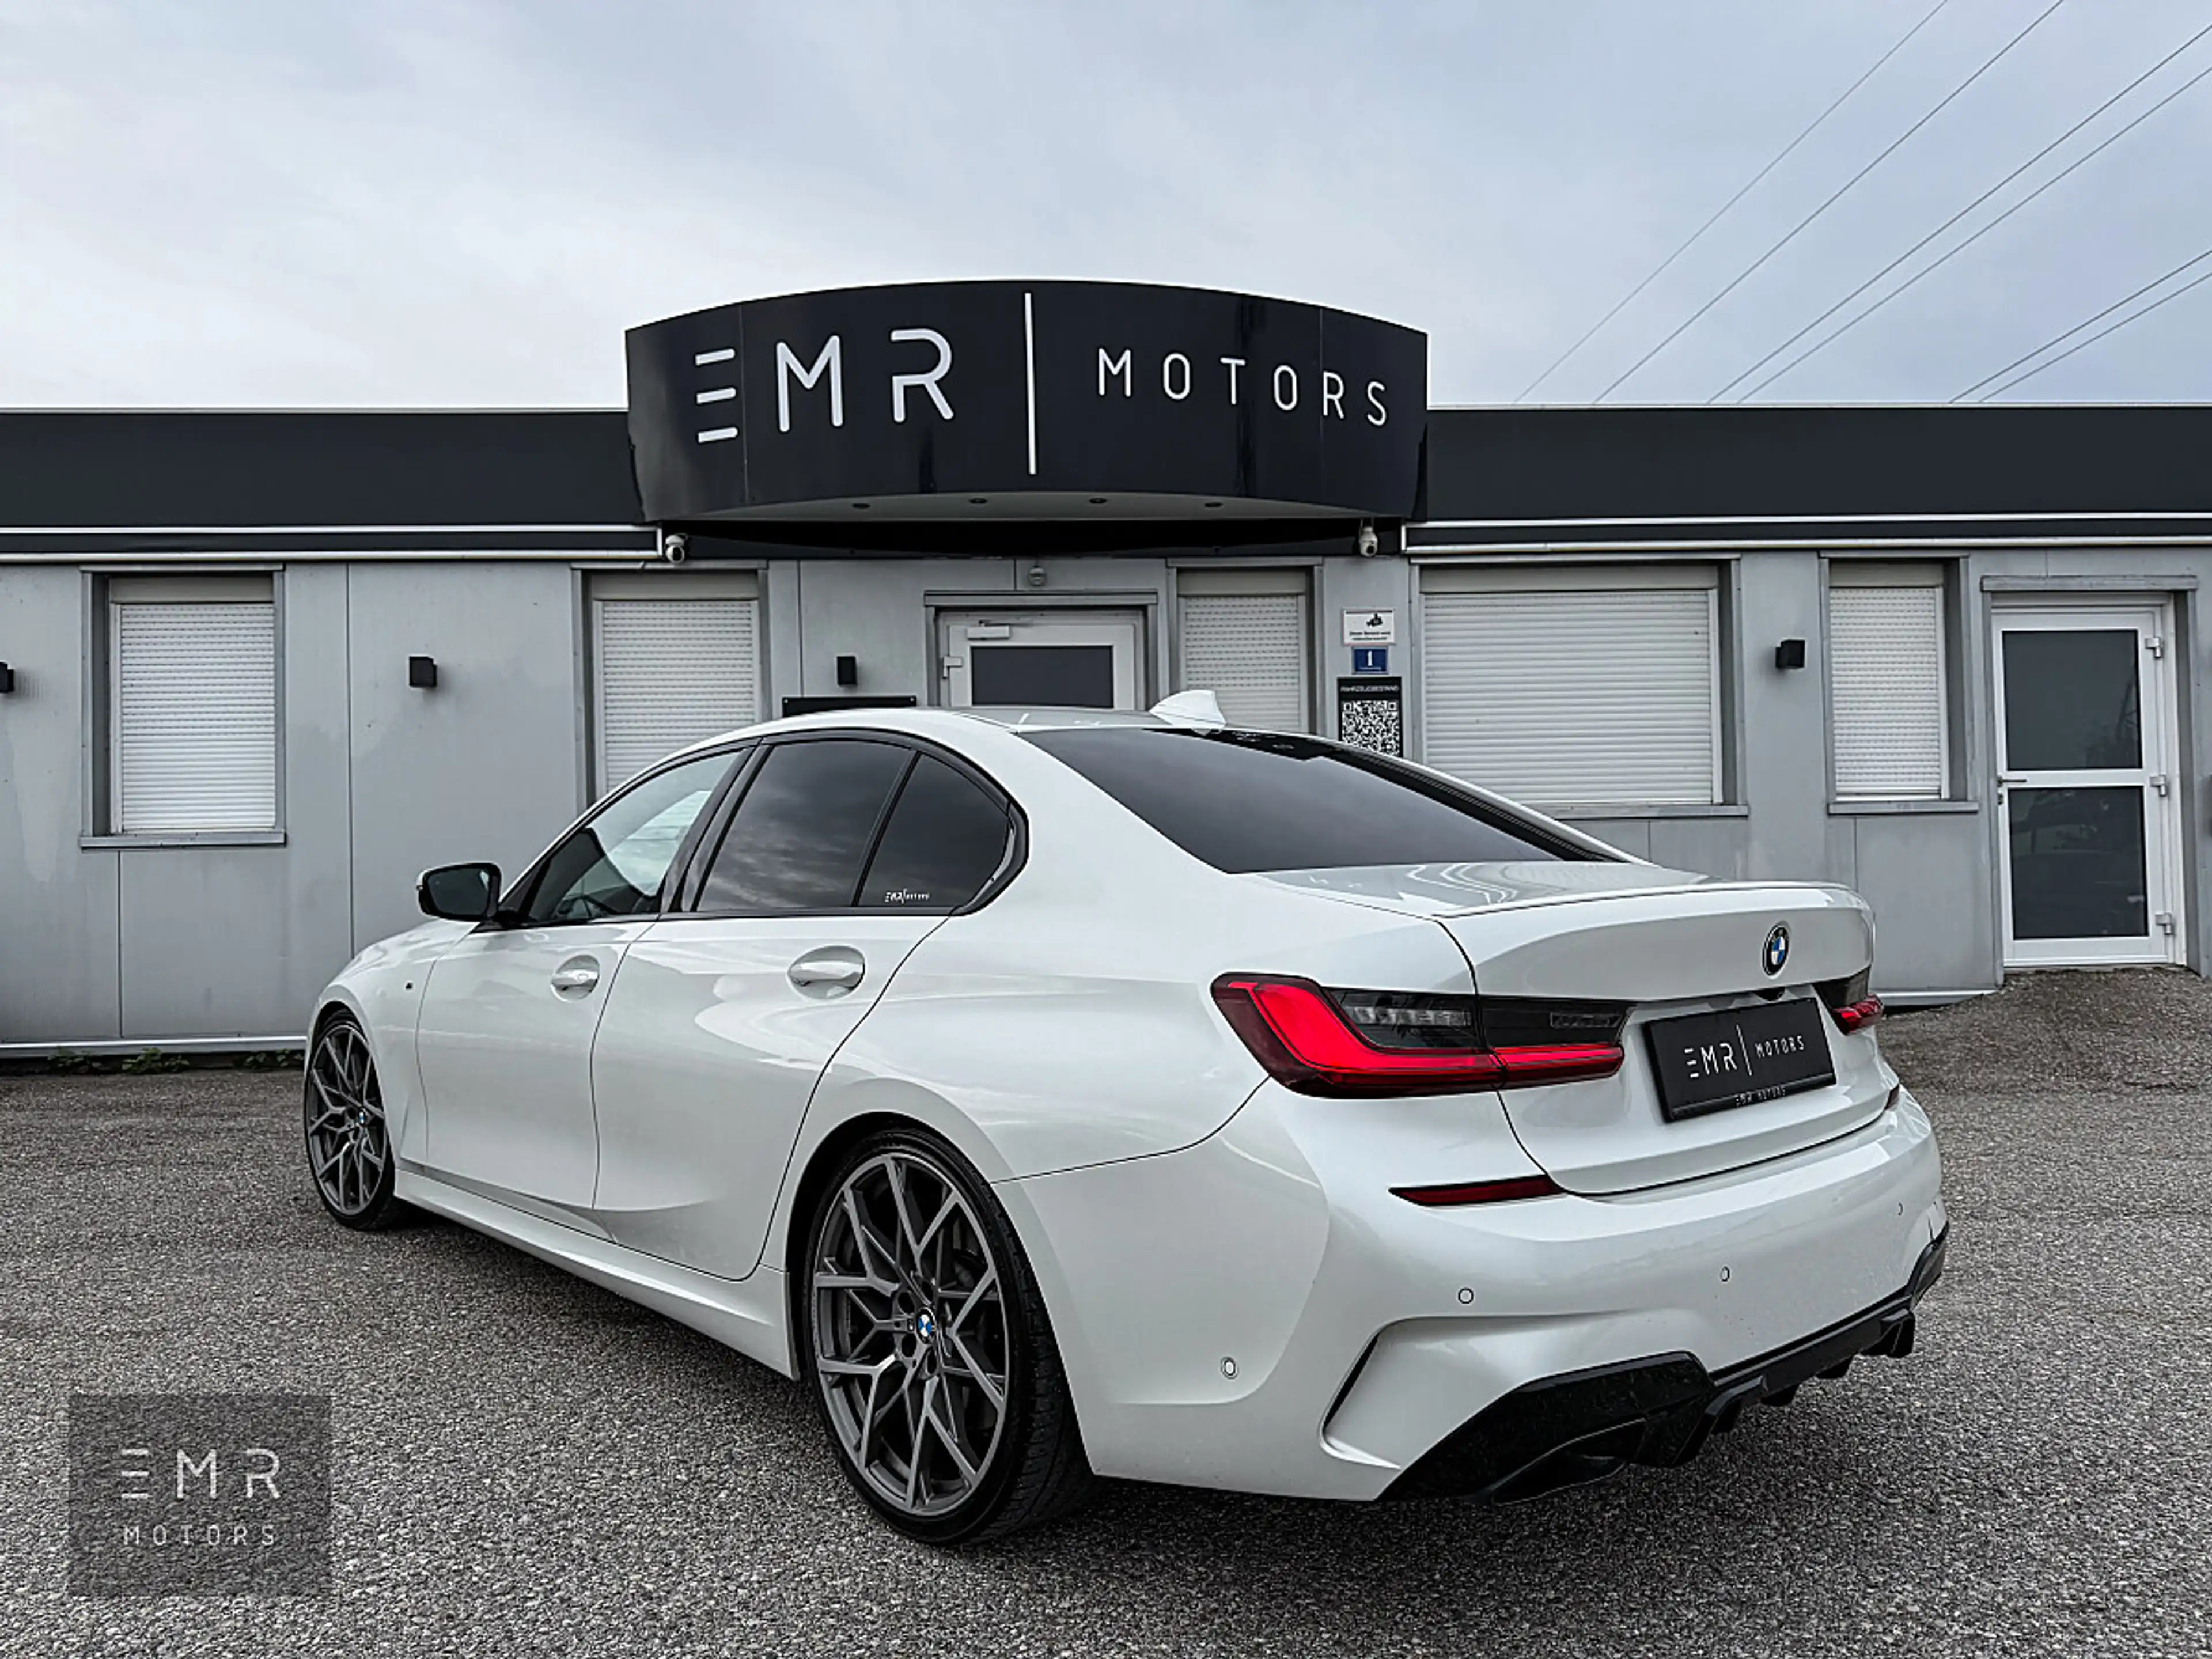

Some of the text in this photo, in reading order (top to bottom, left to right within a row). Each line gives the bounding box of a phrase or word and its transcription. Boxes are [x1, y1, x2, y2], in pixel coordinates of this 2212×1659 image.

[695, 328, 1388, 443] EMR MOTORS
[1684, 1035, 1804, 1078] EMR MOTORS
